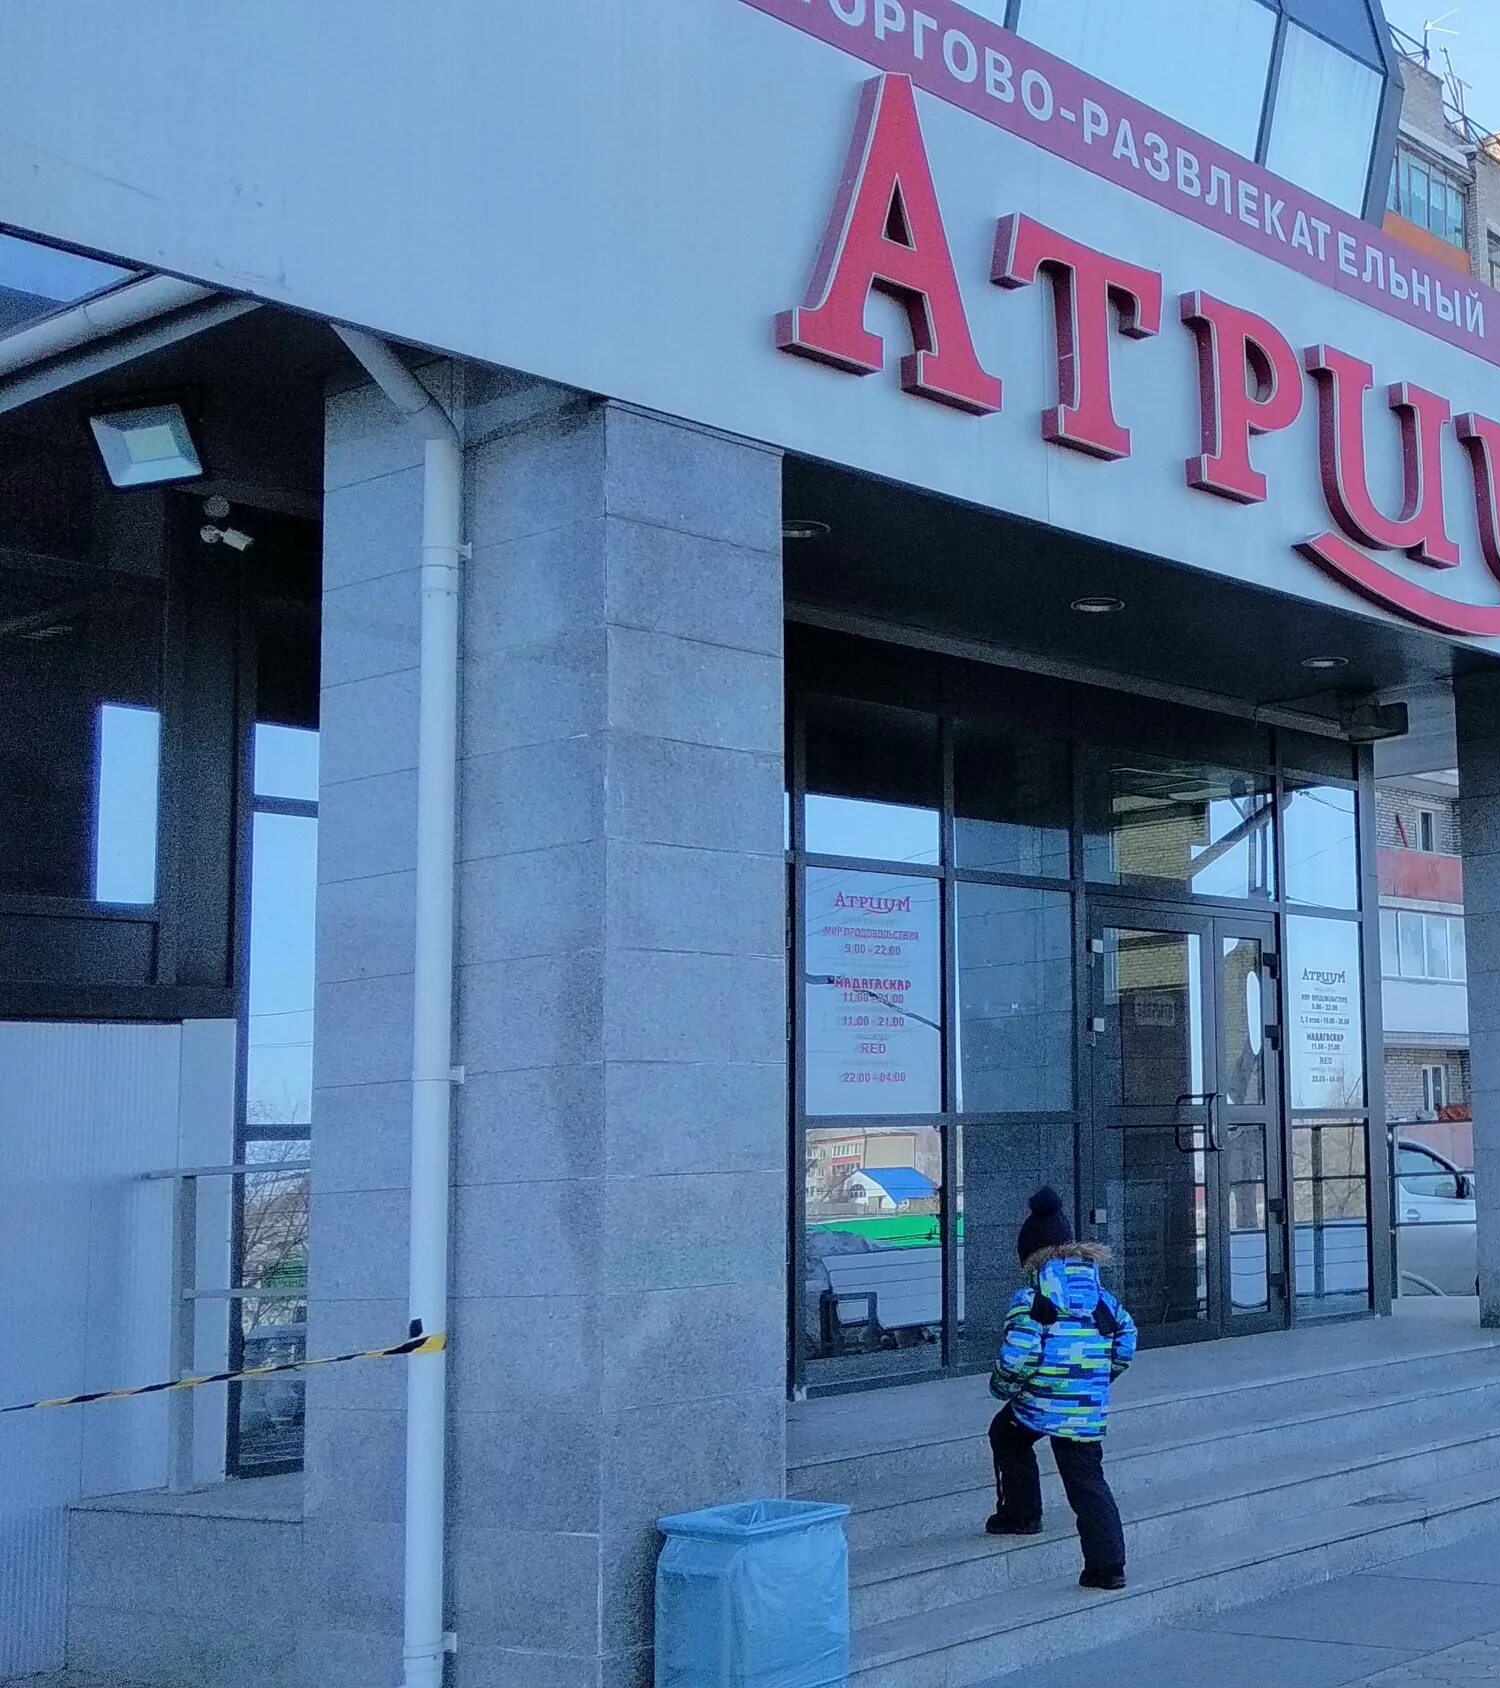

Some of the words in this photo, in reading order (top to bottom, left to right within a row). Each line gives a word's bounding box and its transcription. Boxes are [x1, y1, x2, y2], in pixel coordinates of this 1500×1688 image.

[805, 0, 1485, 339] ОРГОВО-РАЗВЛЕКАТЕЛЬНЫЙ
[835, 977, 911, 990] МАДАГАСКАР
[860, 1043, 886, 1054] RED
